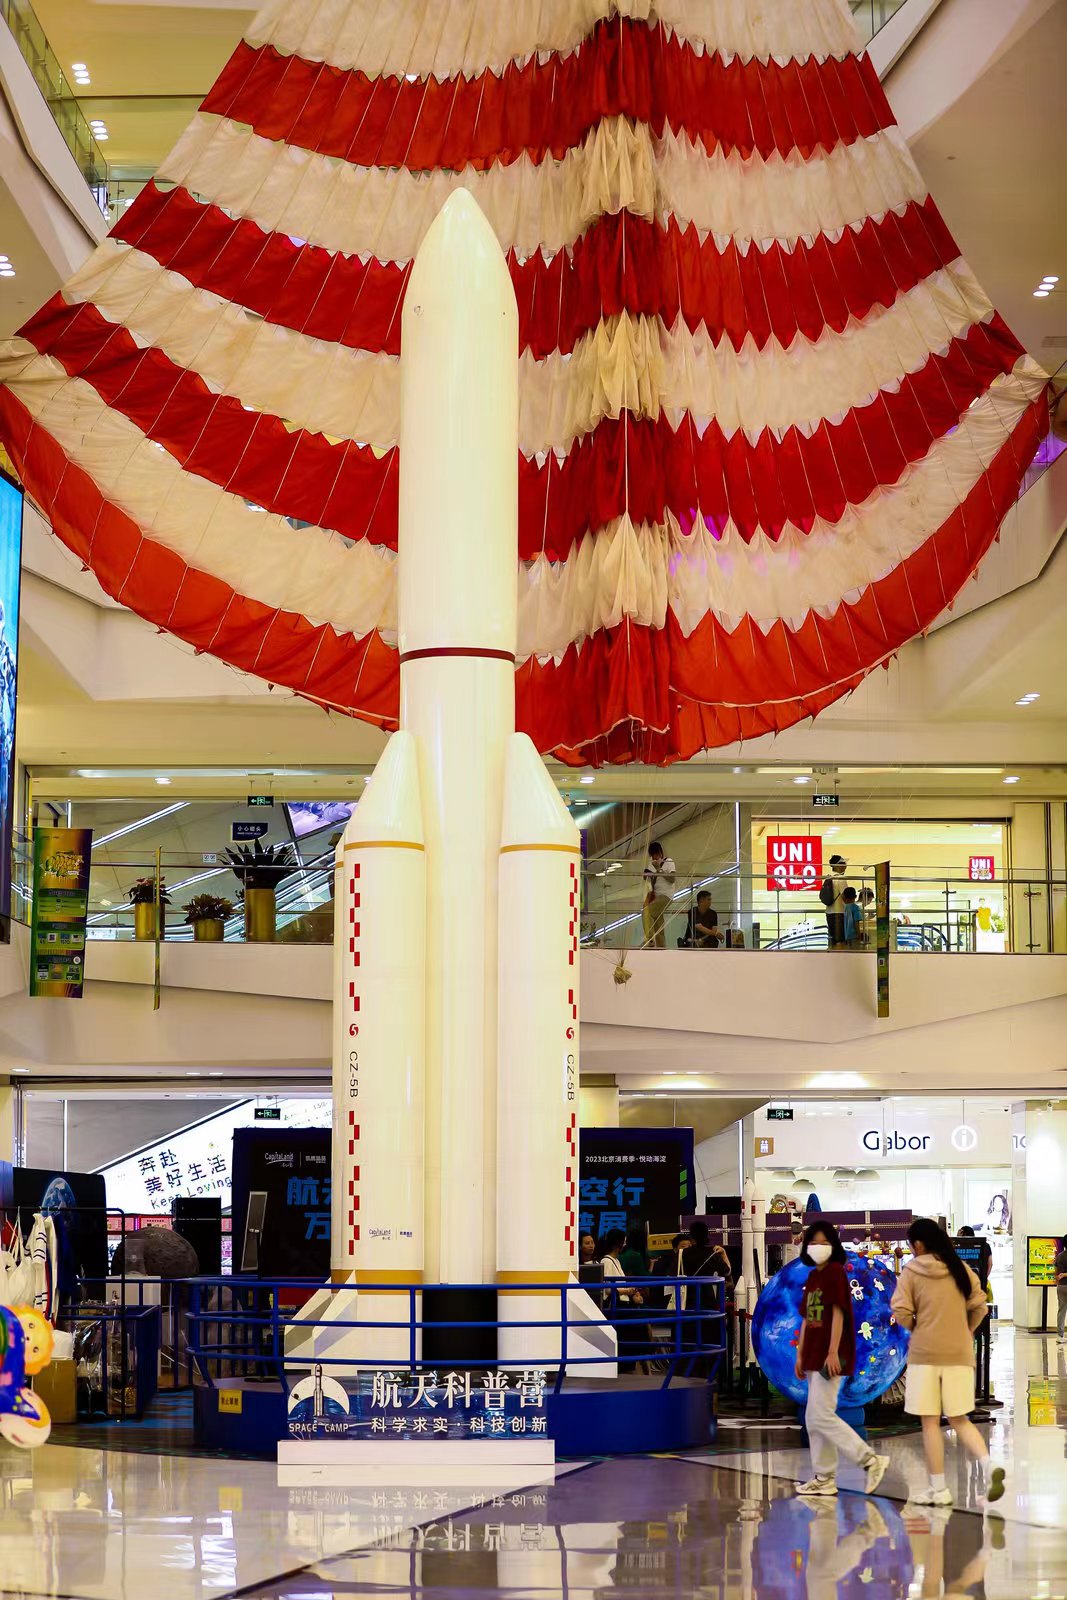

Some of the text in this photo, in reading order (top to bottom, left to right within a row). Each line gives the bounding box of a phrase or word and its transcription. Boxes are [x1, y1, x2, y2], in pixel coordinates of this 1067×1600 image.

[773, 842, 812, 862] UNI
[971, 858, 991, 869] UNI
[773, 864, 816, 888] QLO
[349, 1051, 359, 1098] CZ-5B
[566, 1054, 575, 1101] CZ-5B
[863, 1130, 931, 1151] Gabor
[144, 1153, 227, 1196] 美好生活
[371, 1371, 547, 1409] 航天科普营
[288, 1423, 349, 1433] SPACE CAMP
